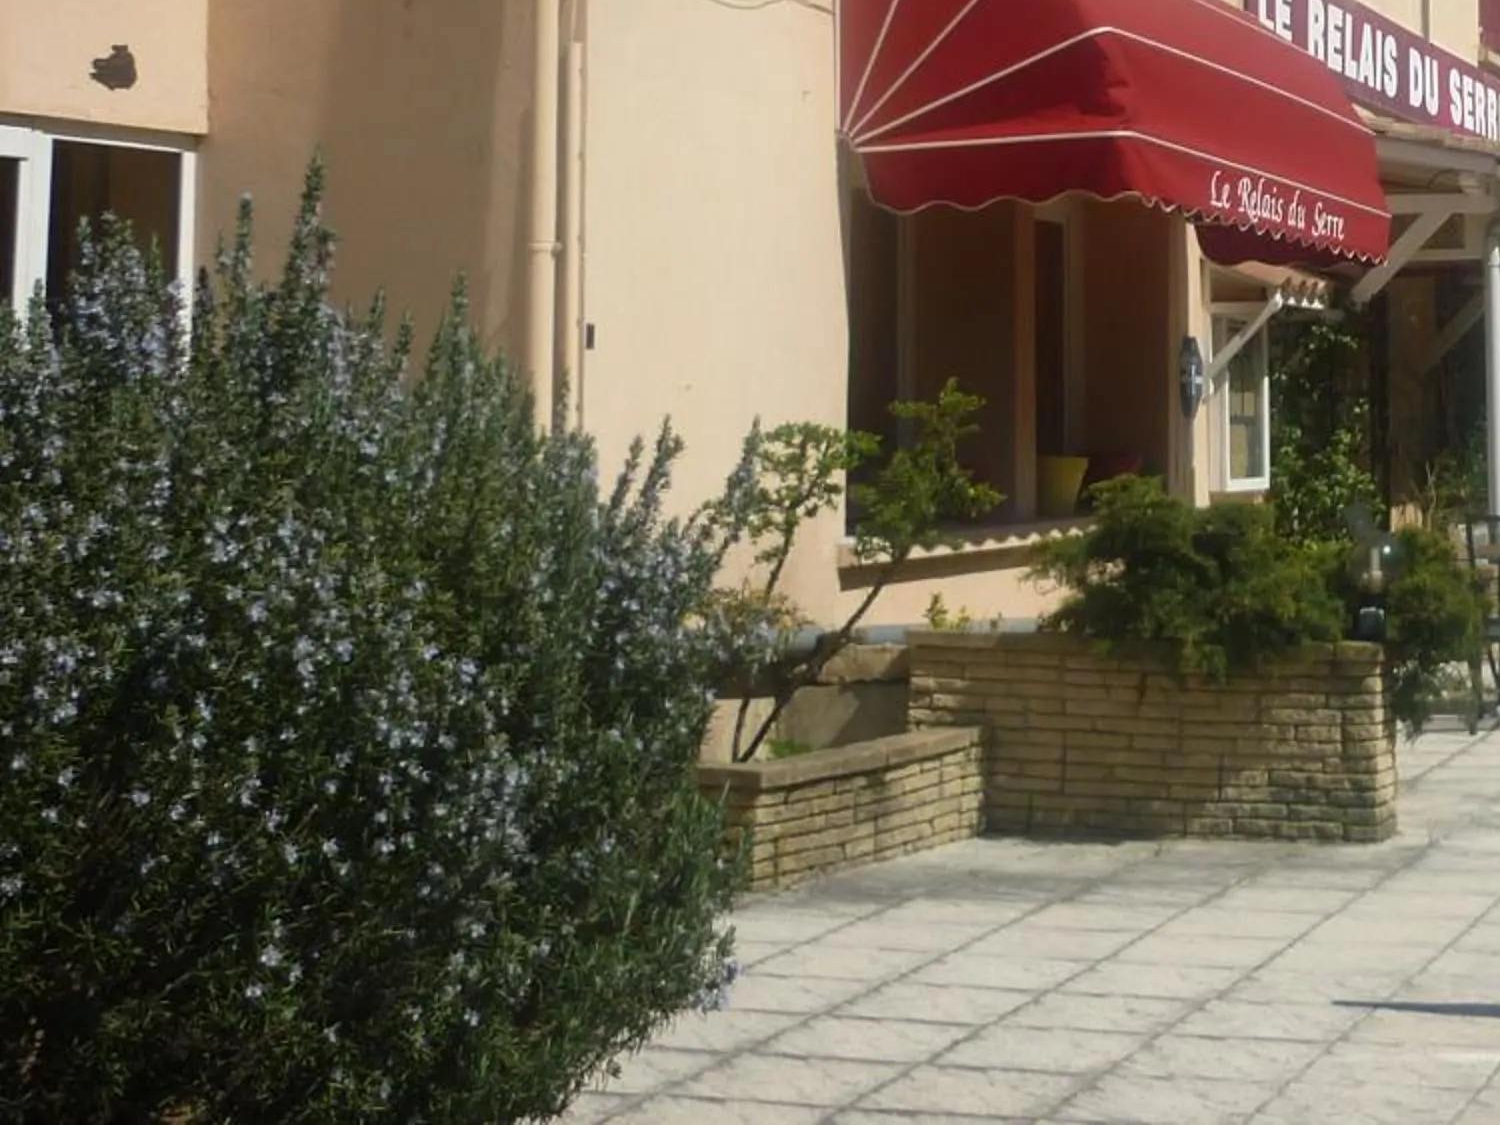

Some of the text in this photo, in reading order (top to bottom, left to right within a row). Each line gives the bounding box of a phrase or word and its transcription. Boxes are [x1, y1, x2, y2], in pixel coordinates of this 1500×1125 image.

[1409, 47, 1439, 116] DU
[1209, 170, 1345, 241] Le Relais du Serre
